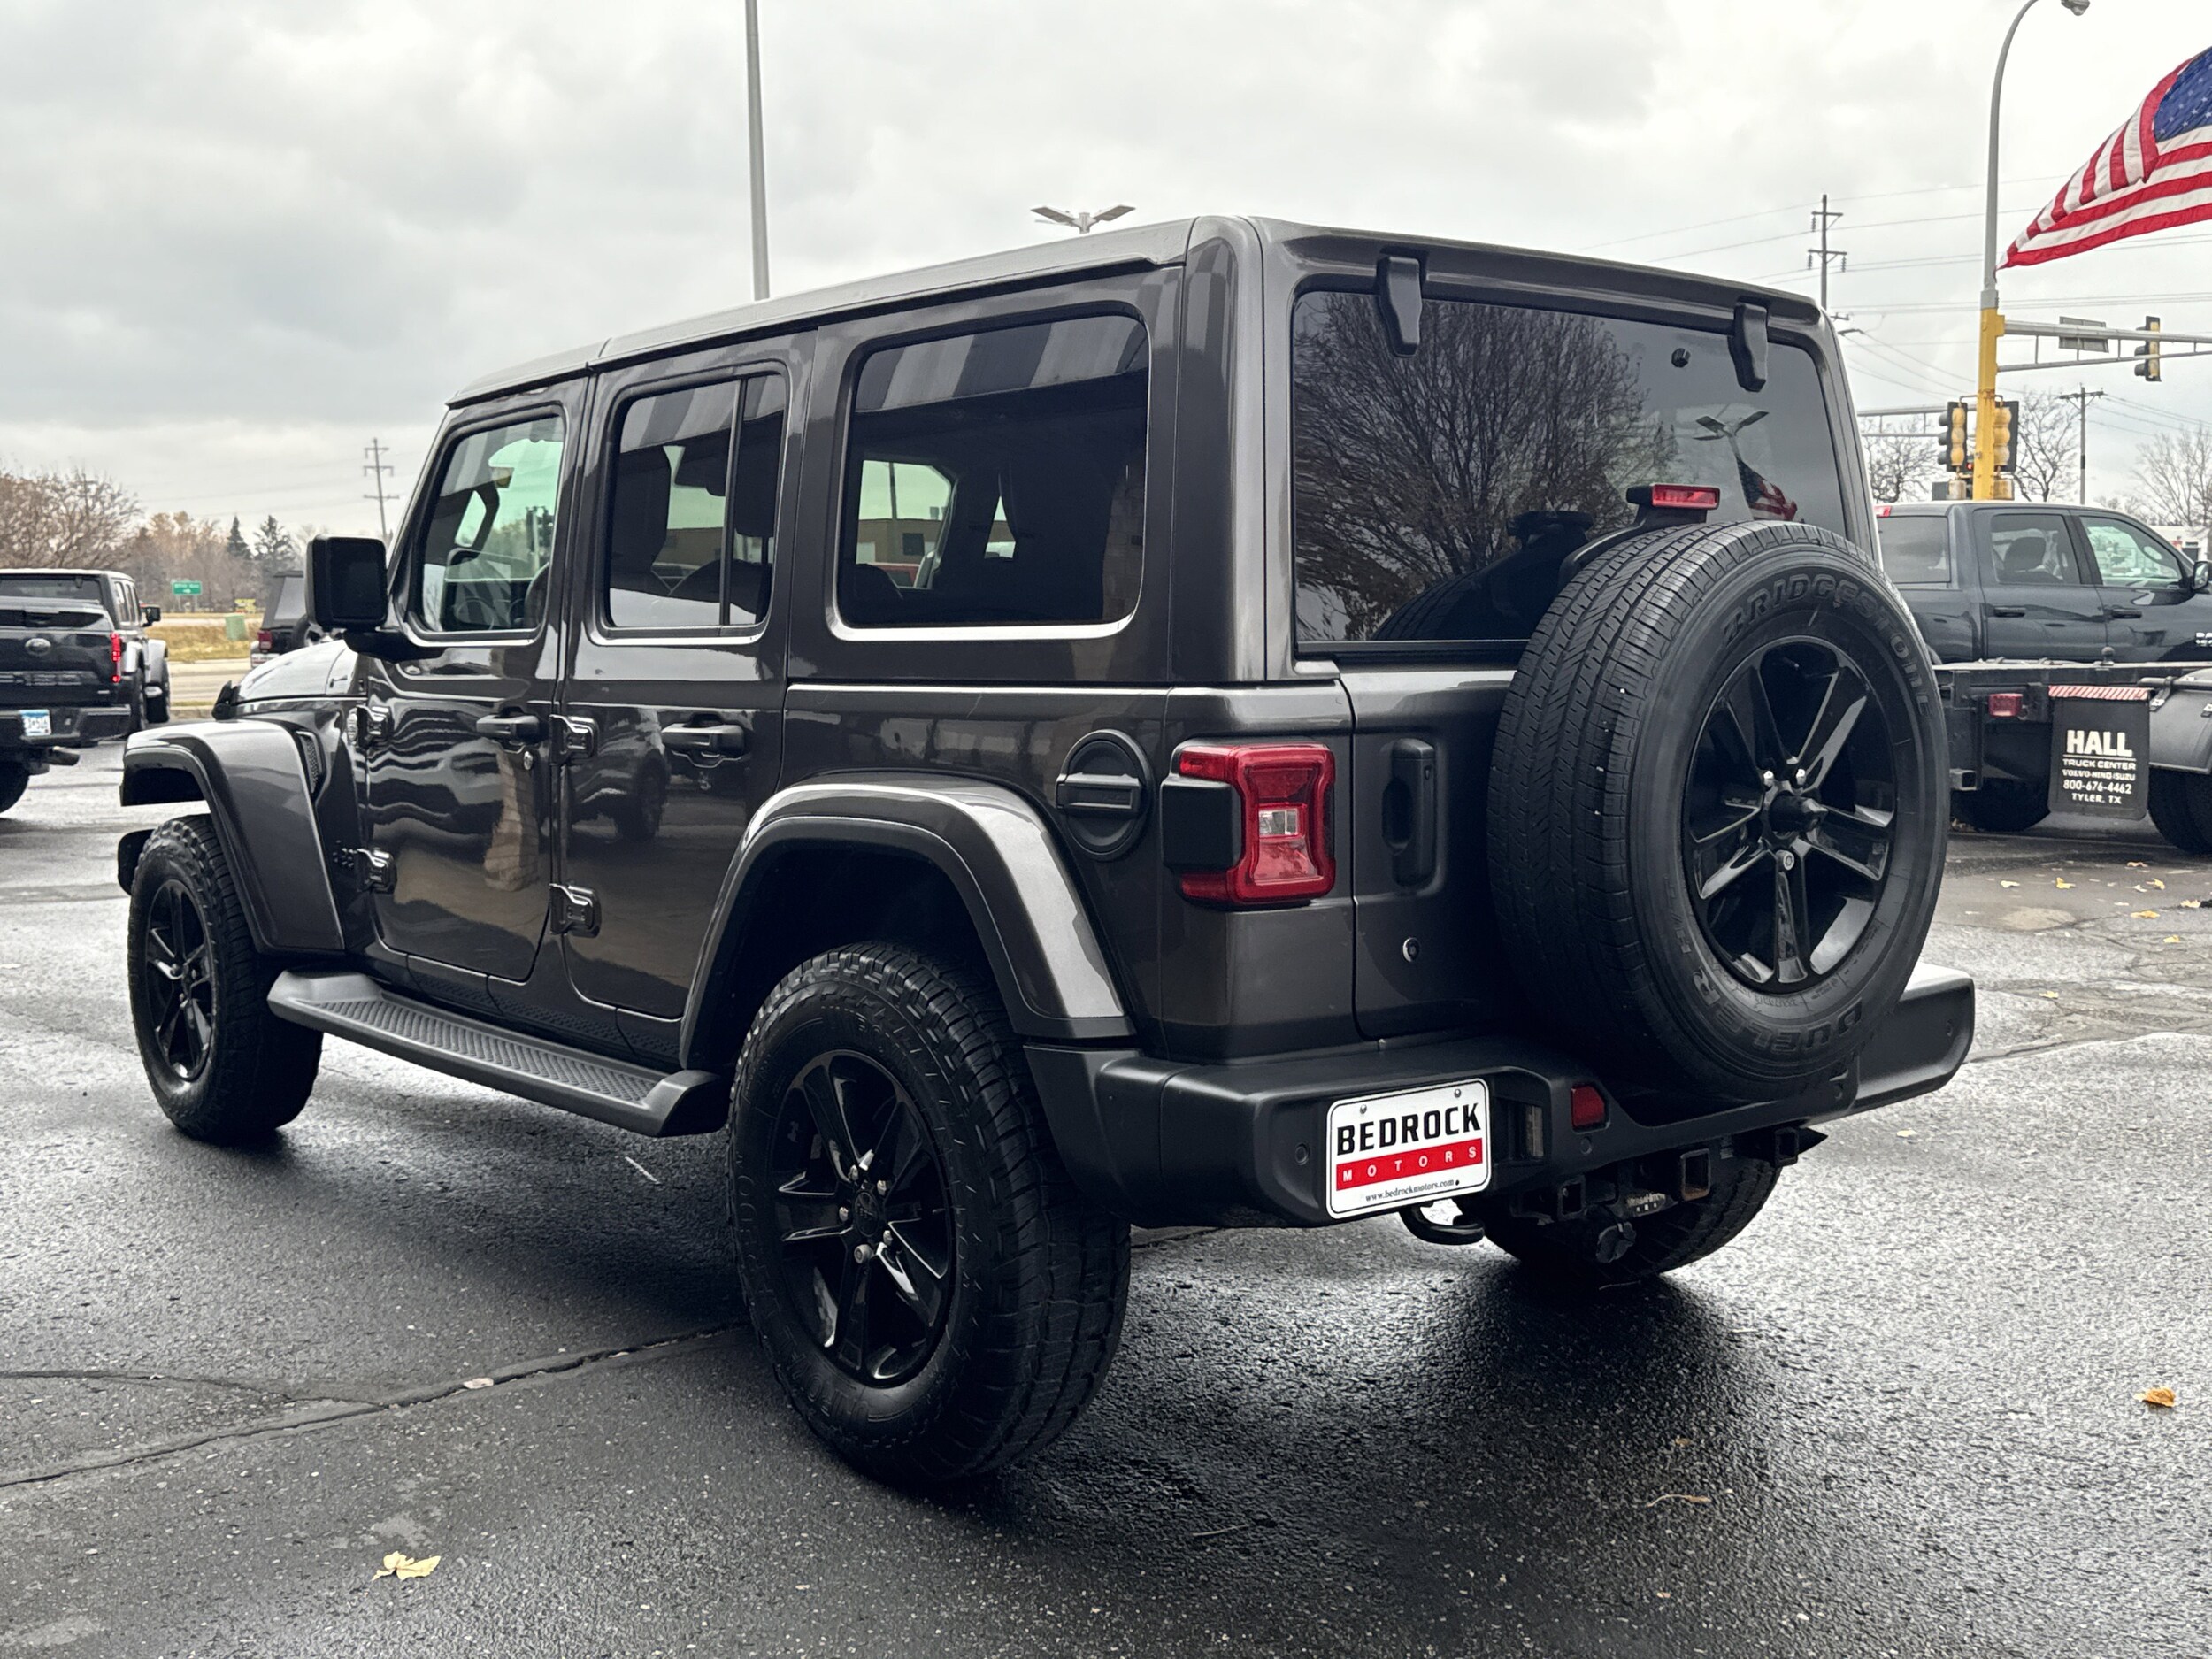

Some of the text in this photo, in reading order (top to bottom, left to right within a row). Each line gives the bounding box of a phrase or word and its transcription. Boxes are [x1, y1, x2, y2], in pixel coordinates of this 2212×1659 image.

[1723, 572, 1932, 716] BRIDGESTONE
[2066, 729, 2133, 757] HALL
[2062, 758, 2136, 771] TRUCK CENTER
[2062, 779, 2132, 795] 800-676-4462
[2108, 795, 2122, 804] TX
[1694, 965, 1862, 1054] DUELER
[1337, 1102, 1481, 1156] BEDROCK
[1342, 1146, 1477, 1182] MOTORS
[1365, 1179, 1455, 1202] www.bedrockmotors.com
